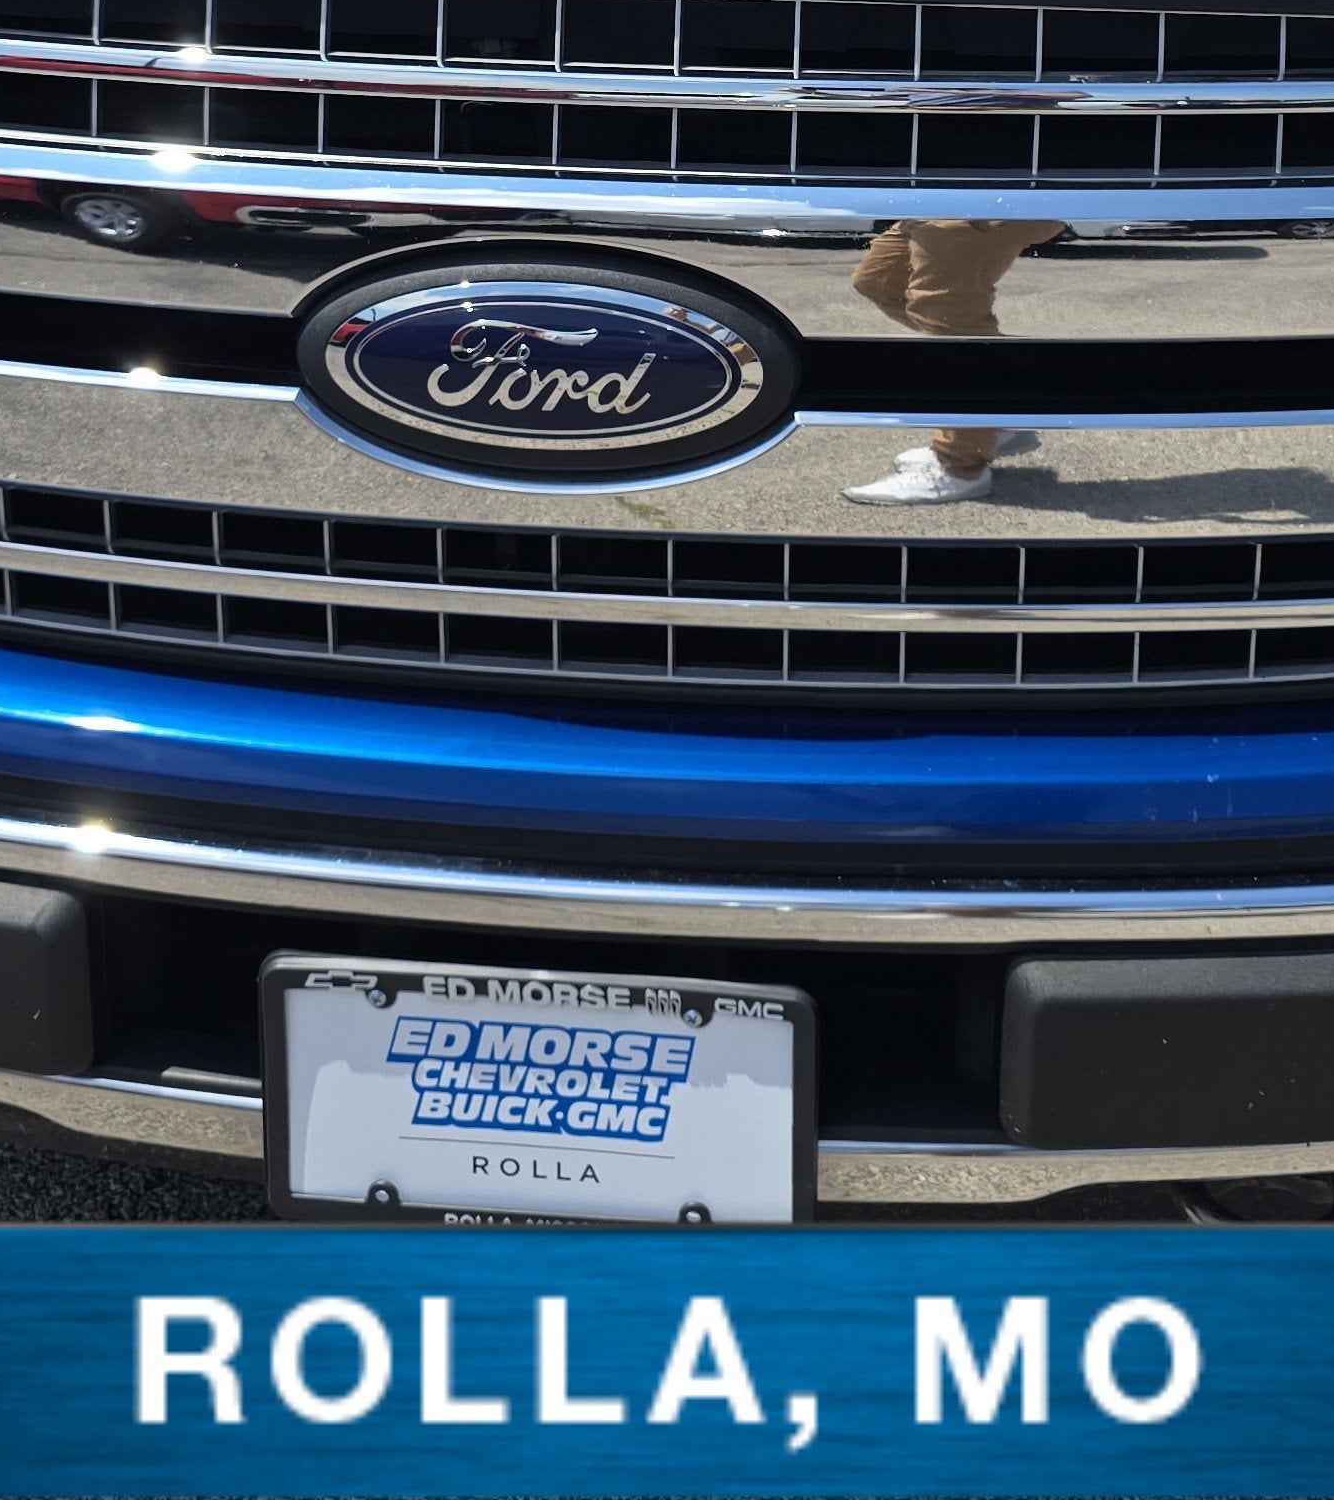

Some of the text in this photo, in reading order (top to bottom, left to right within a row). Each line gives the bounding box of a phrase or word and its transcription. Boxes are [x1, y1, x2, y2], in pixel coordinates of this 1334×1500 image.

[427, 318, 656, 415] Ford
[422, 975, 631, 1011] ED MORSE
[713, 998, 785, 1021] GMC
[390, 1023, 690, 1075] ED MORSE
[472, 1155, 600, 1183] ROLLA
